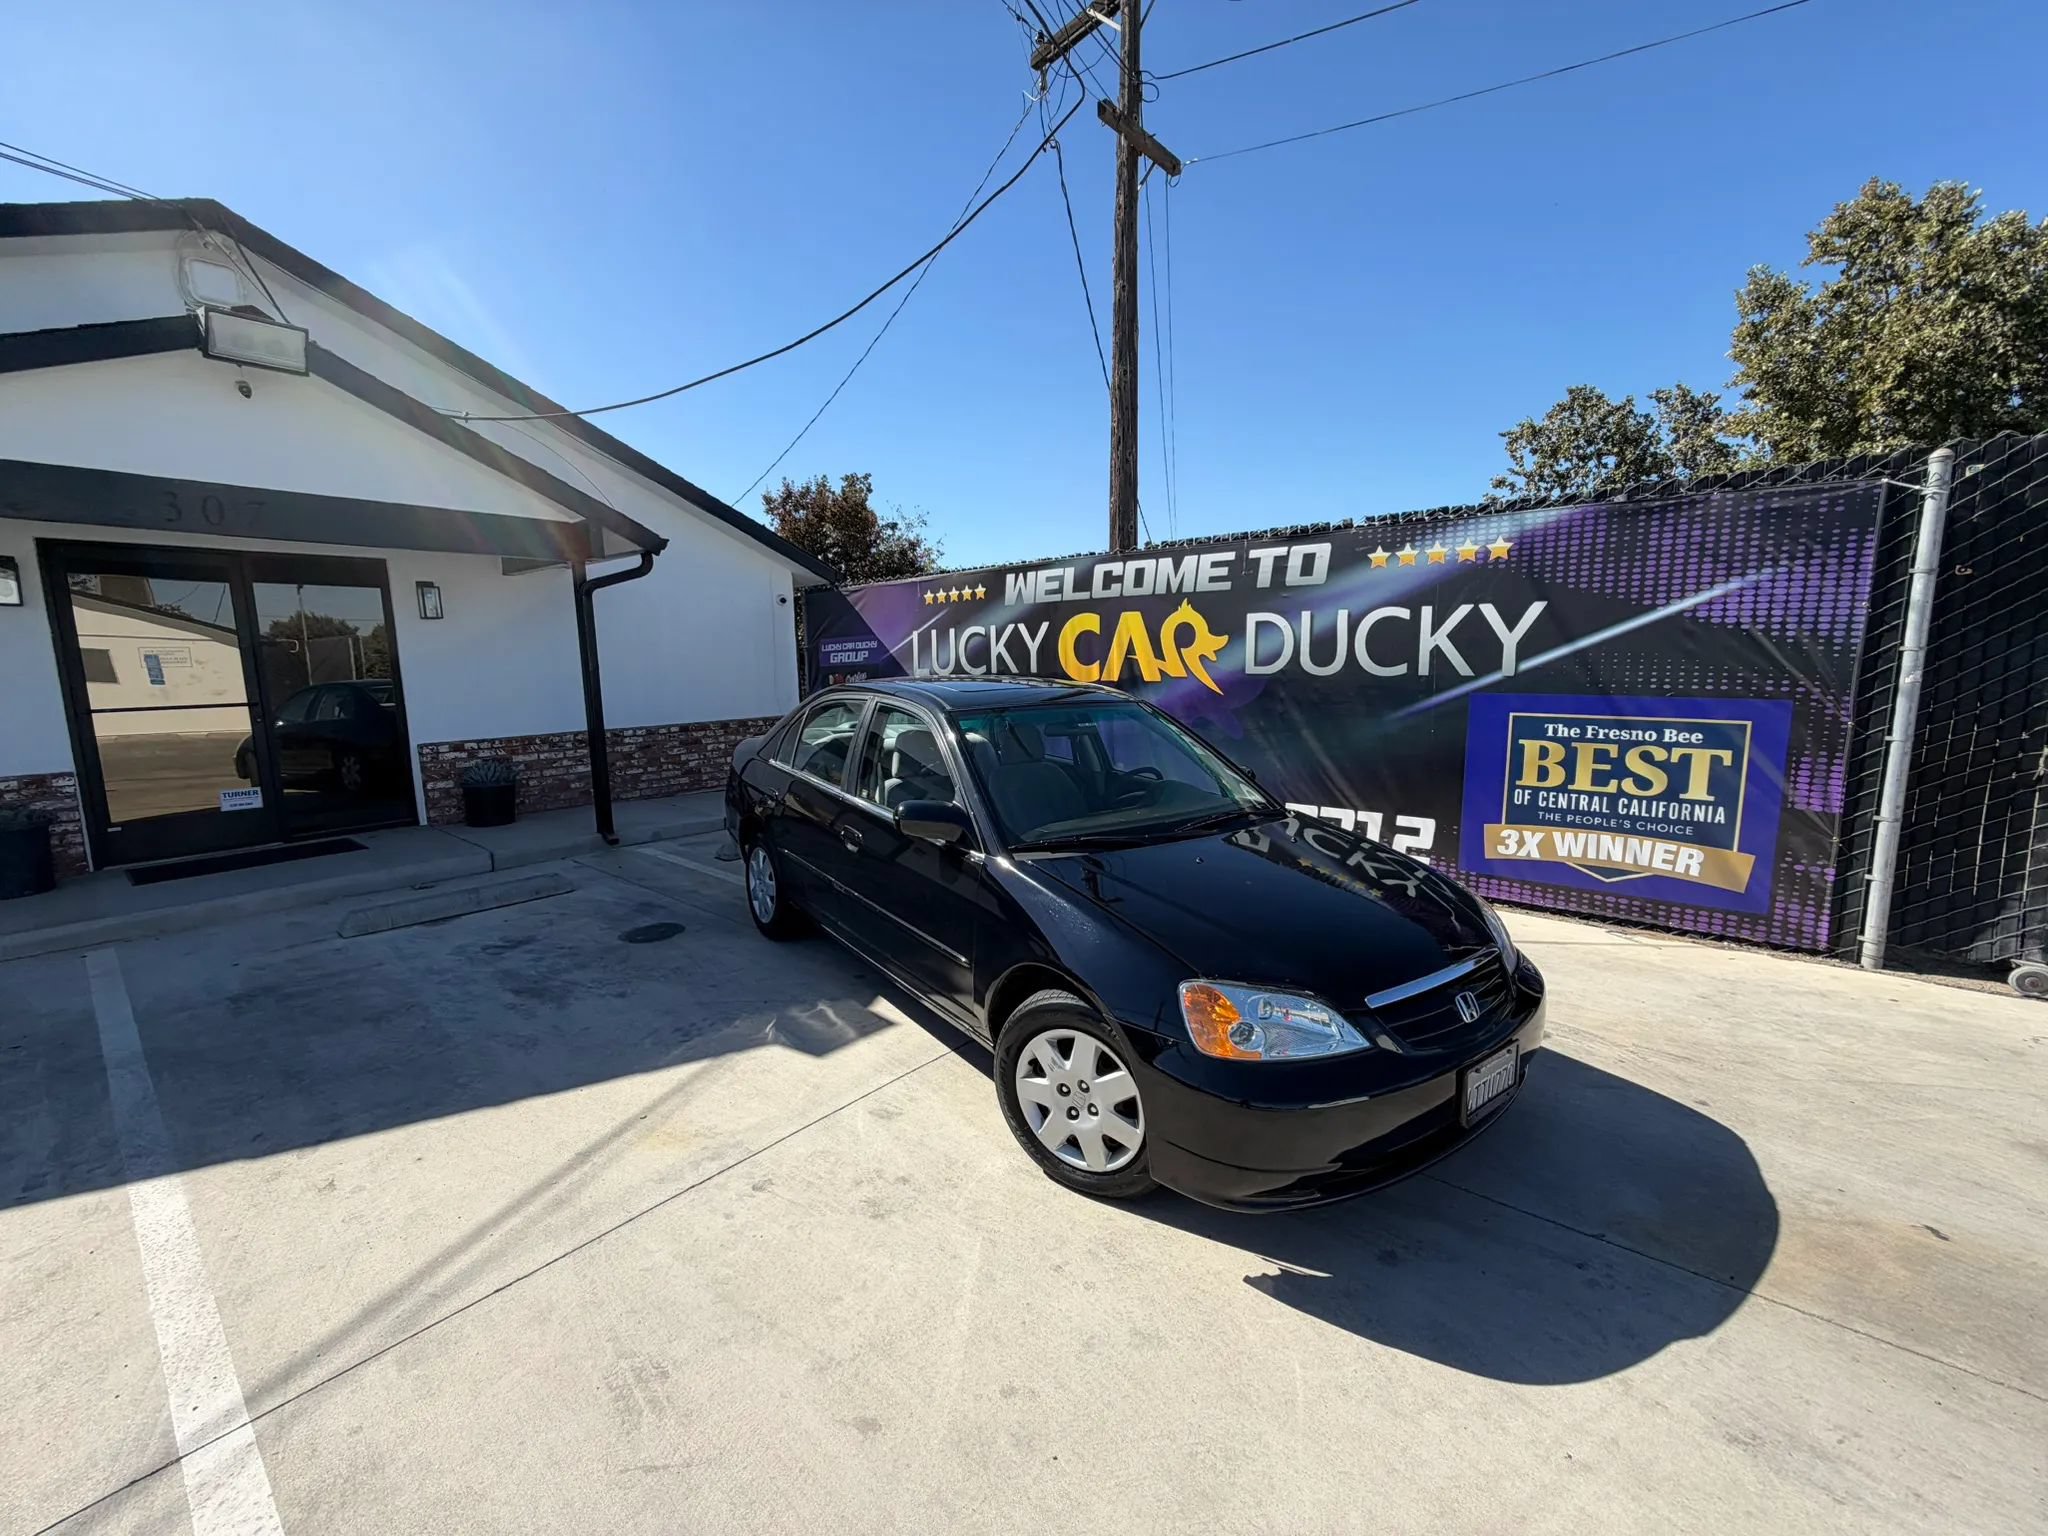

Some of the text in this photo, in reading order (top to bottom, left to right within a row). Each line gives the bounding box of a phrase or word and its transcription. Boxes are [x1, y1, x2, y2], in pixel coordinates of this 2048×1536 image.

[1004, 542, 1332, 606] WELCOME TO
[822, 640, 878, 651] LUCKY CAR DUCKY
[830, 651, 869, 663] GROUP
[911, 597, 1549, 696] LUCKY CAR DUCKY
[1544, 723, 1704, 744] The Fresno Bee
[1515, 739, 1733, 801] BEST
[222, 789, 259, 798] TURNER
[1514, 788, 1726, 824] OF CENTRAL CALIFORNIA
[1538, 811, 1694, 836] THE PEOPLE'S CHOICE
[1496, 829, 1705, 876] 3X WINNER
